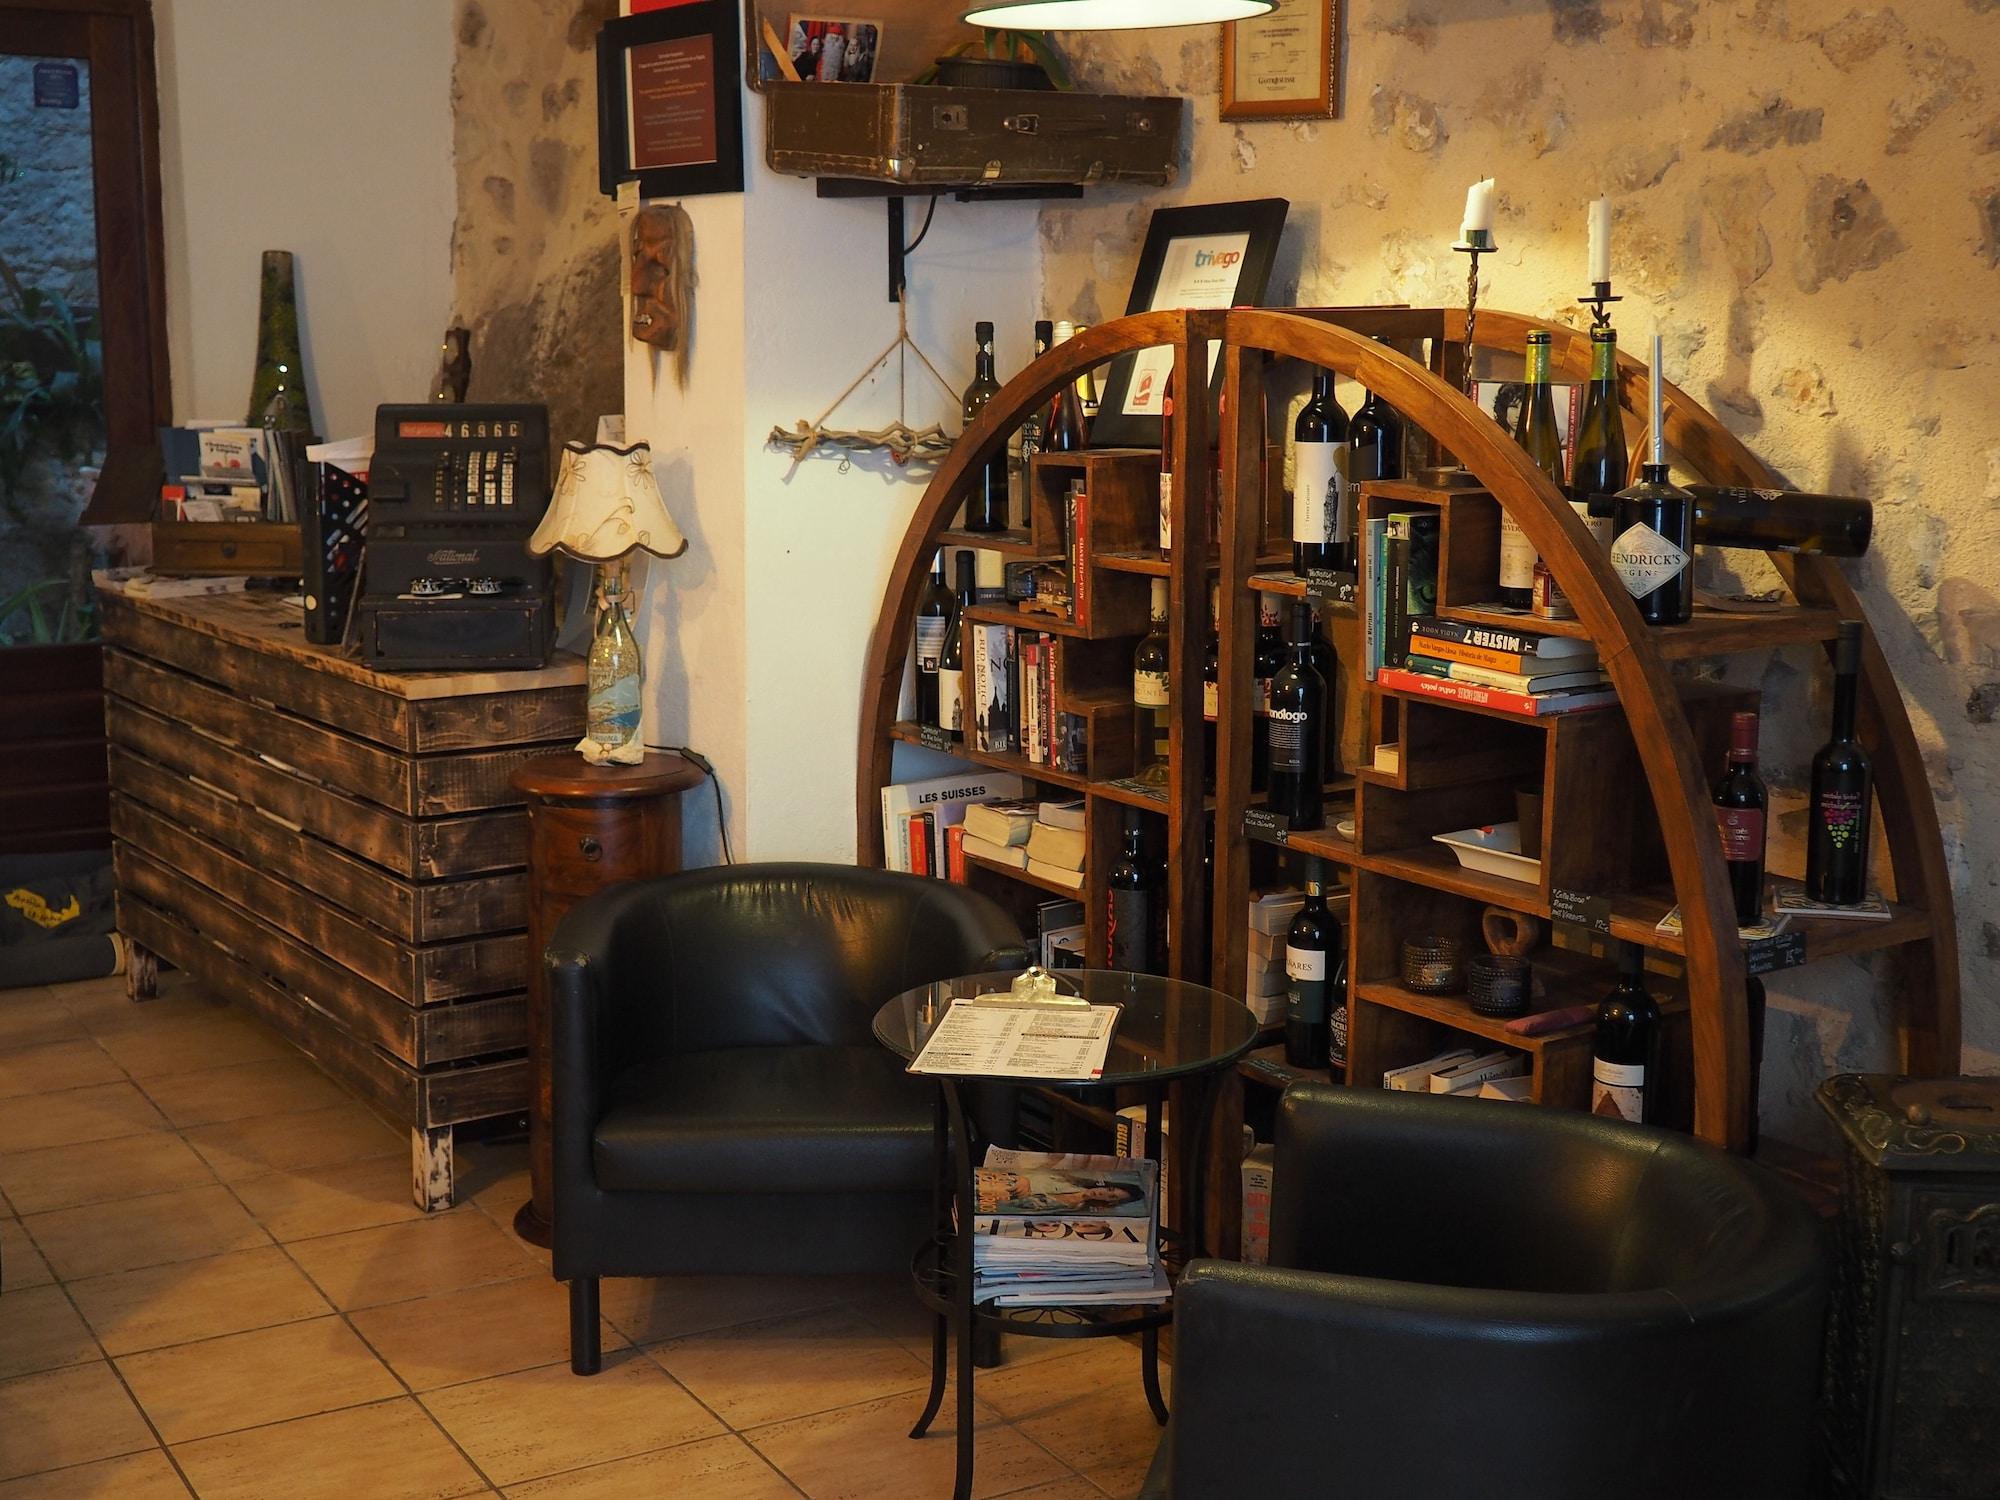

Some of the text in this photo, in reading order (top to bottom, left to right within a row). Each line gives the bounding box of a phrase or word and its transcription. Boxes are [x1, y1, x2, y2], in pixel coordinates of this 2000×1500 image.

[1194, 249, 1240, 268] trivago
[427, 550, 480, 564] National
[1463, 629, 1520, 652] MISTER 7
[919, 786, 986, 804] LES SUISSES
